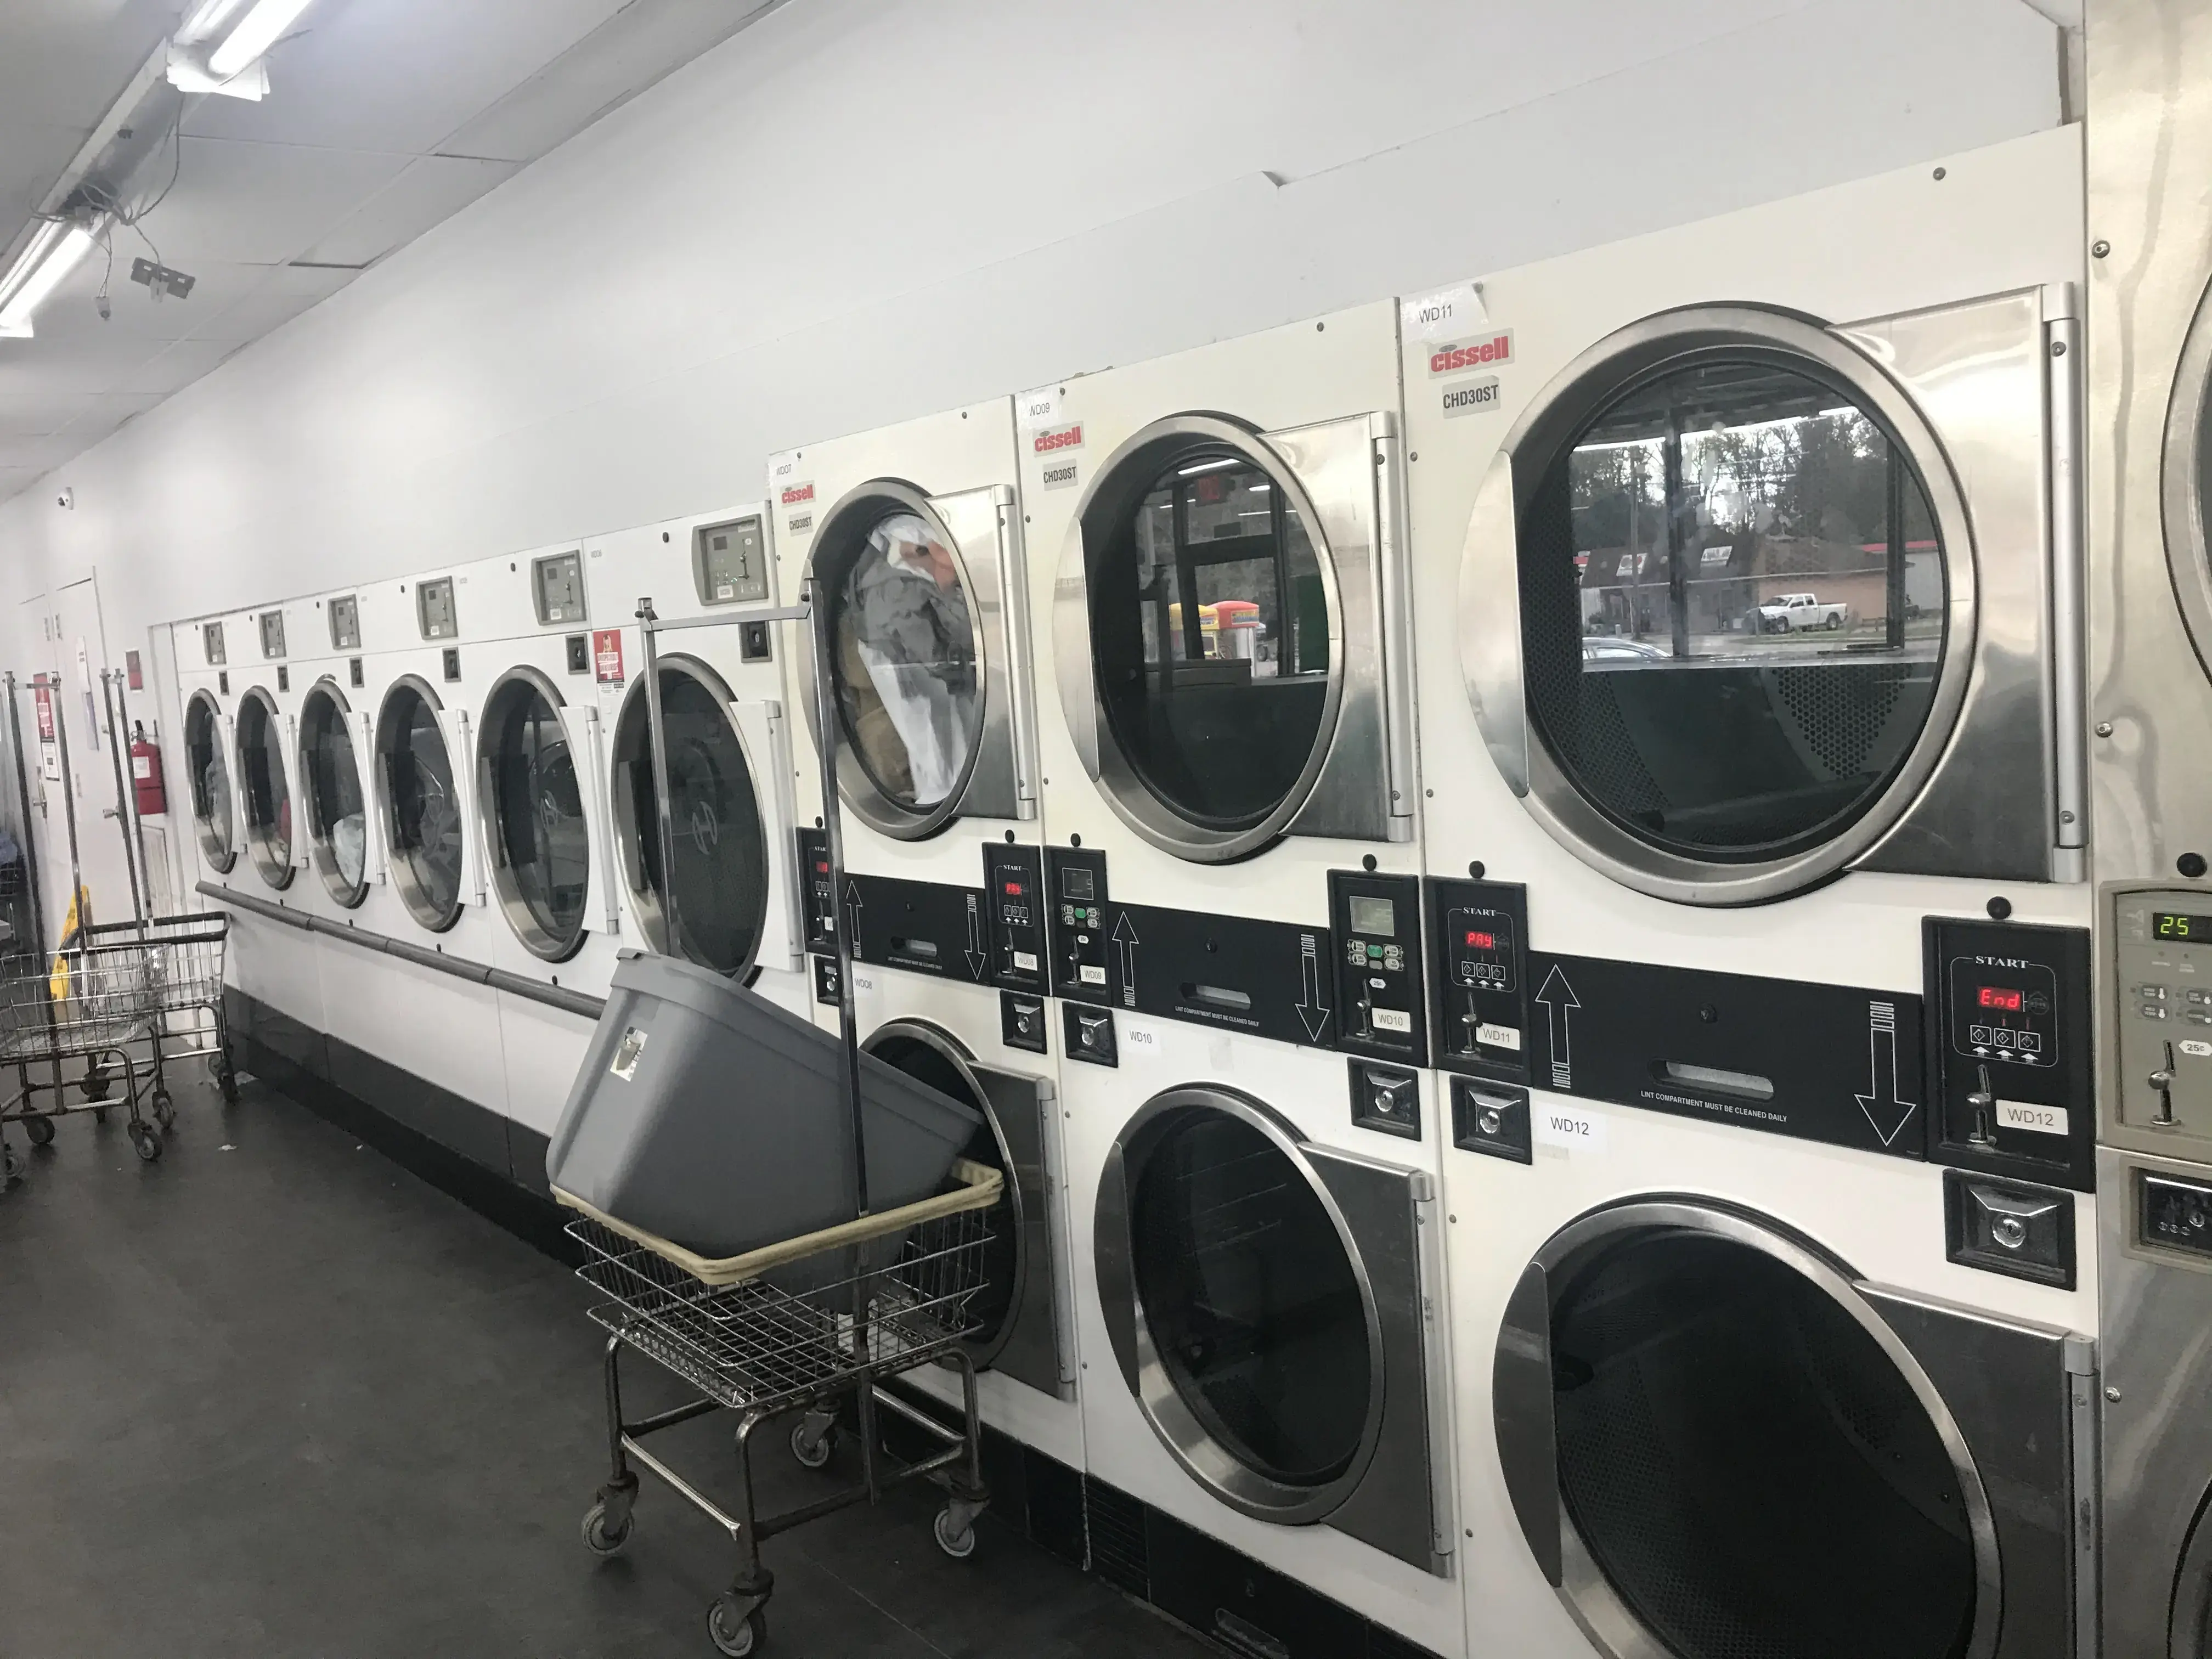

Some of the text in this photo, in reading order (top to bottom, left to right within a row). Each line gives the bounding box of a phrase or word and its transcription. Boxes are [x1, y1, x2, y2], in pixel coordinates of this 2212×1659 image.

[1419, 303, 1452, 323] WD11
[1430, 336, 1509, 373] cissell
[1442, 384, 1499, 409] CHD30ST
[1034, 426, 1082, 452] cissell
[1043, 466, 1076, 484] CHD30ST
[781, 484, 814, 504] cissell
[789, 516, 812, 531] CHD30ST
[1463, 907, 1497, 916] START
[2160, 916, 2189, 935] 25
[1976, 956, 2029, 968] START
[1084, 969, 1102, 980] WD09
[855, 978, 872, 990] WD08
[1980, 989, 2021, 1008] End
[1378, 1013, 1403, 1026] WD10
[1129, 1030, 1152, 1044] WD10
[1482, 1028, 1510, 1043] WD11
[1640, 1090, 1787, 1122] LINT COMPARTMENT MUST BE CLEANED DAILY
[1550, 1116, 1589, 1136] WD12
[2007, 1108, 2054, 1126] WD12
